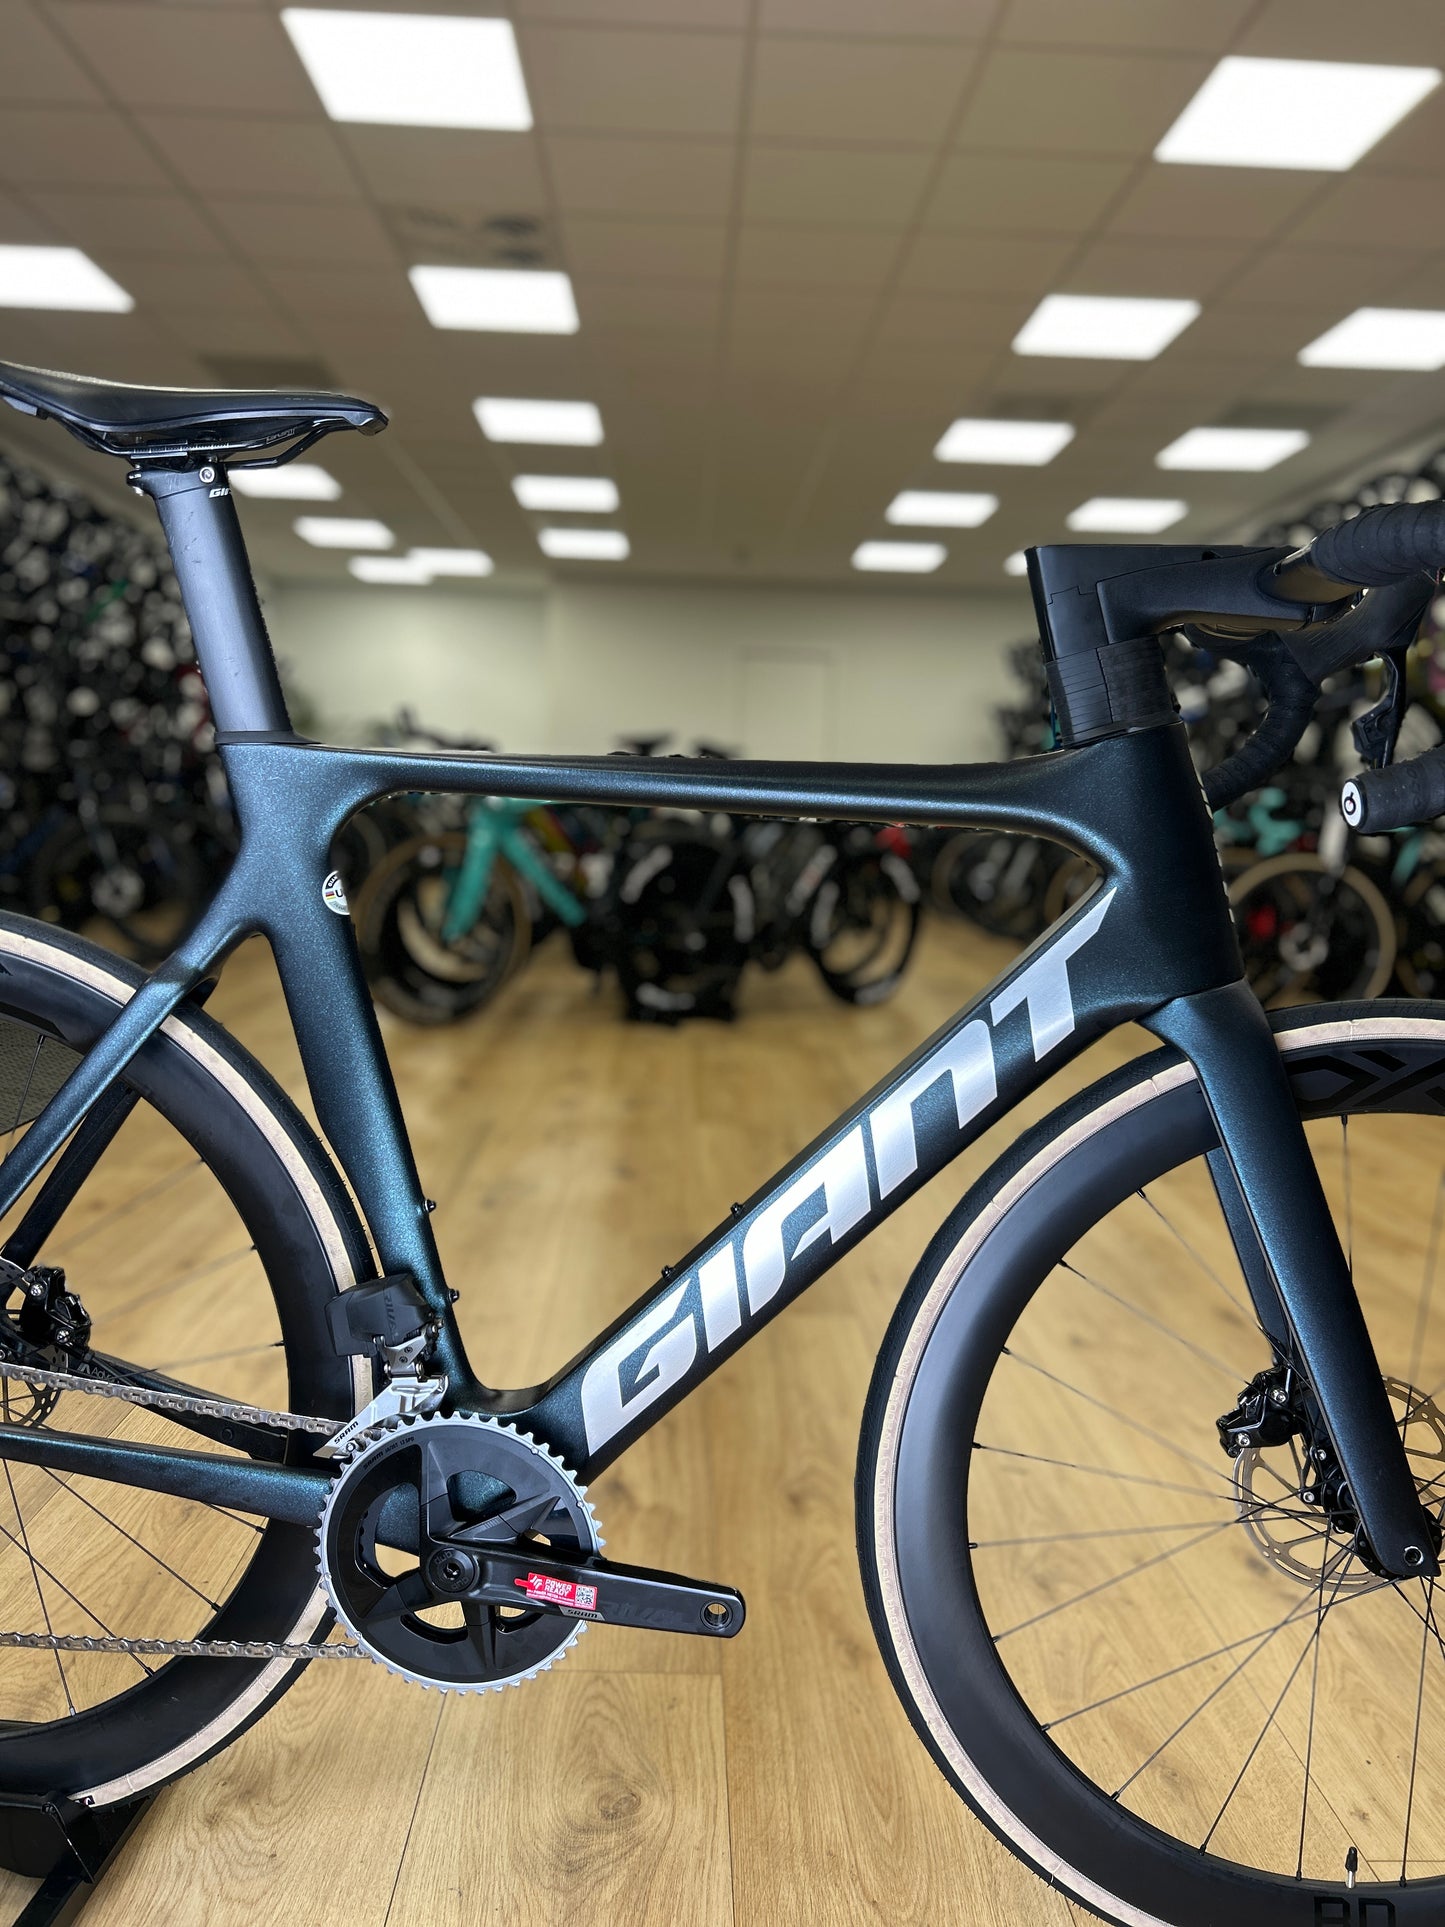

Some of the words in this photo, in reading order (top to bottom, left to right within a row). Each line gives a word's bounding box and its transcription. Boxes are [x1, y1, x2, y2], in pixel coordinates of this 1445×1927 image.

[581, 887, 1117, 1456] GIANT
[877, 1455, 888, 1485] ONLY
[909, 1282, 943, 1343] ROTATION
[334, 1420, 359, 1444] SRAM
[544, 1584, 570, 1597] READY
[545, 1579, 572, 1591] POWER
[567, 1609, 598, 1619] SRAM
